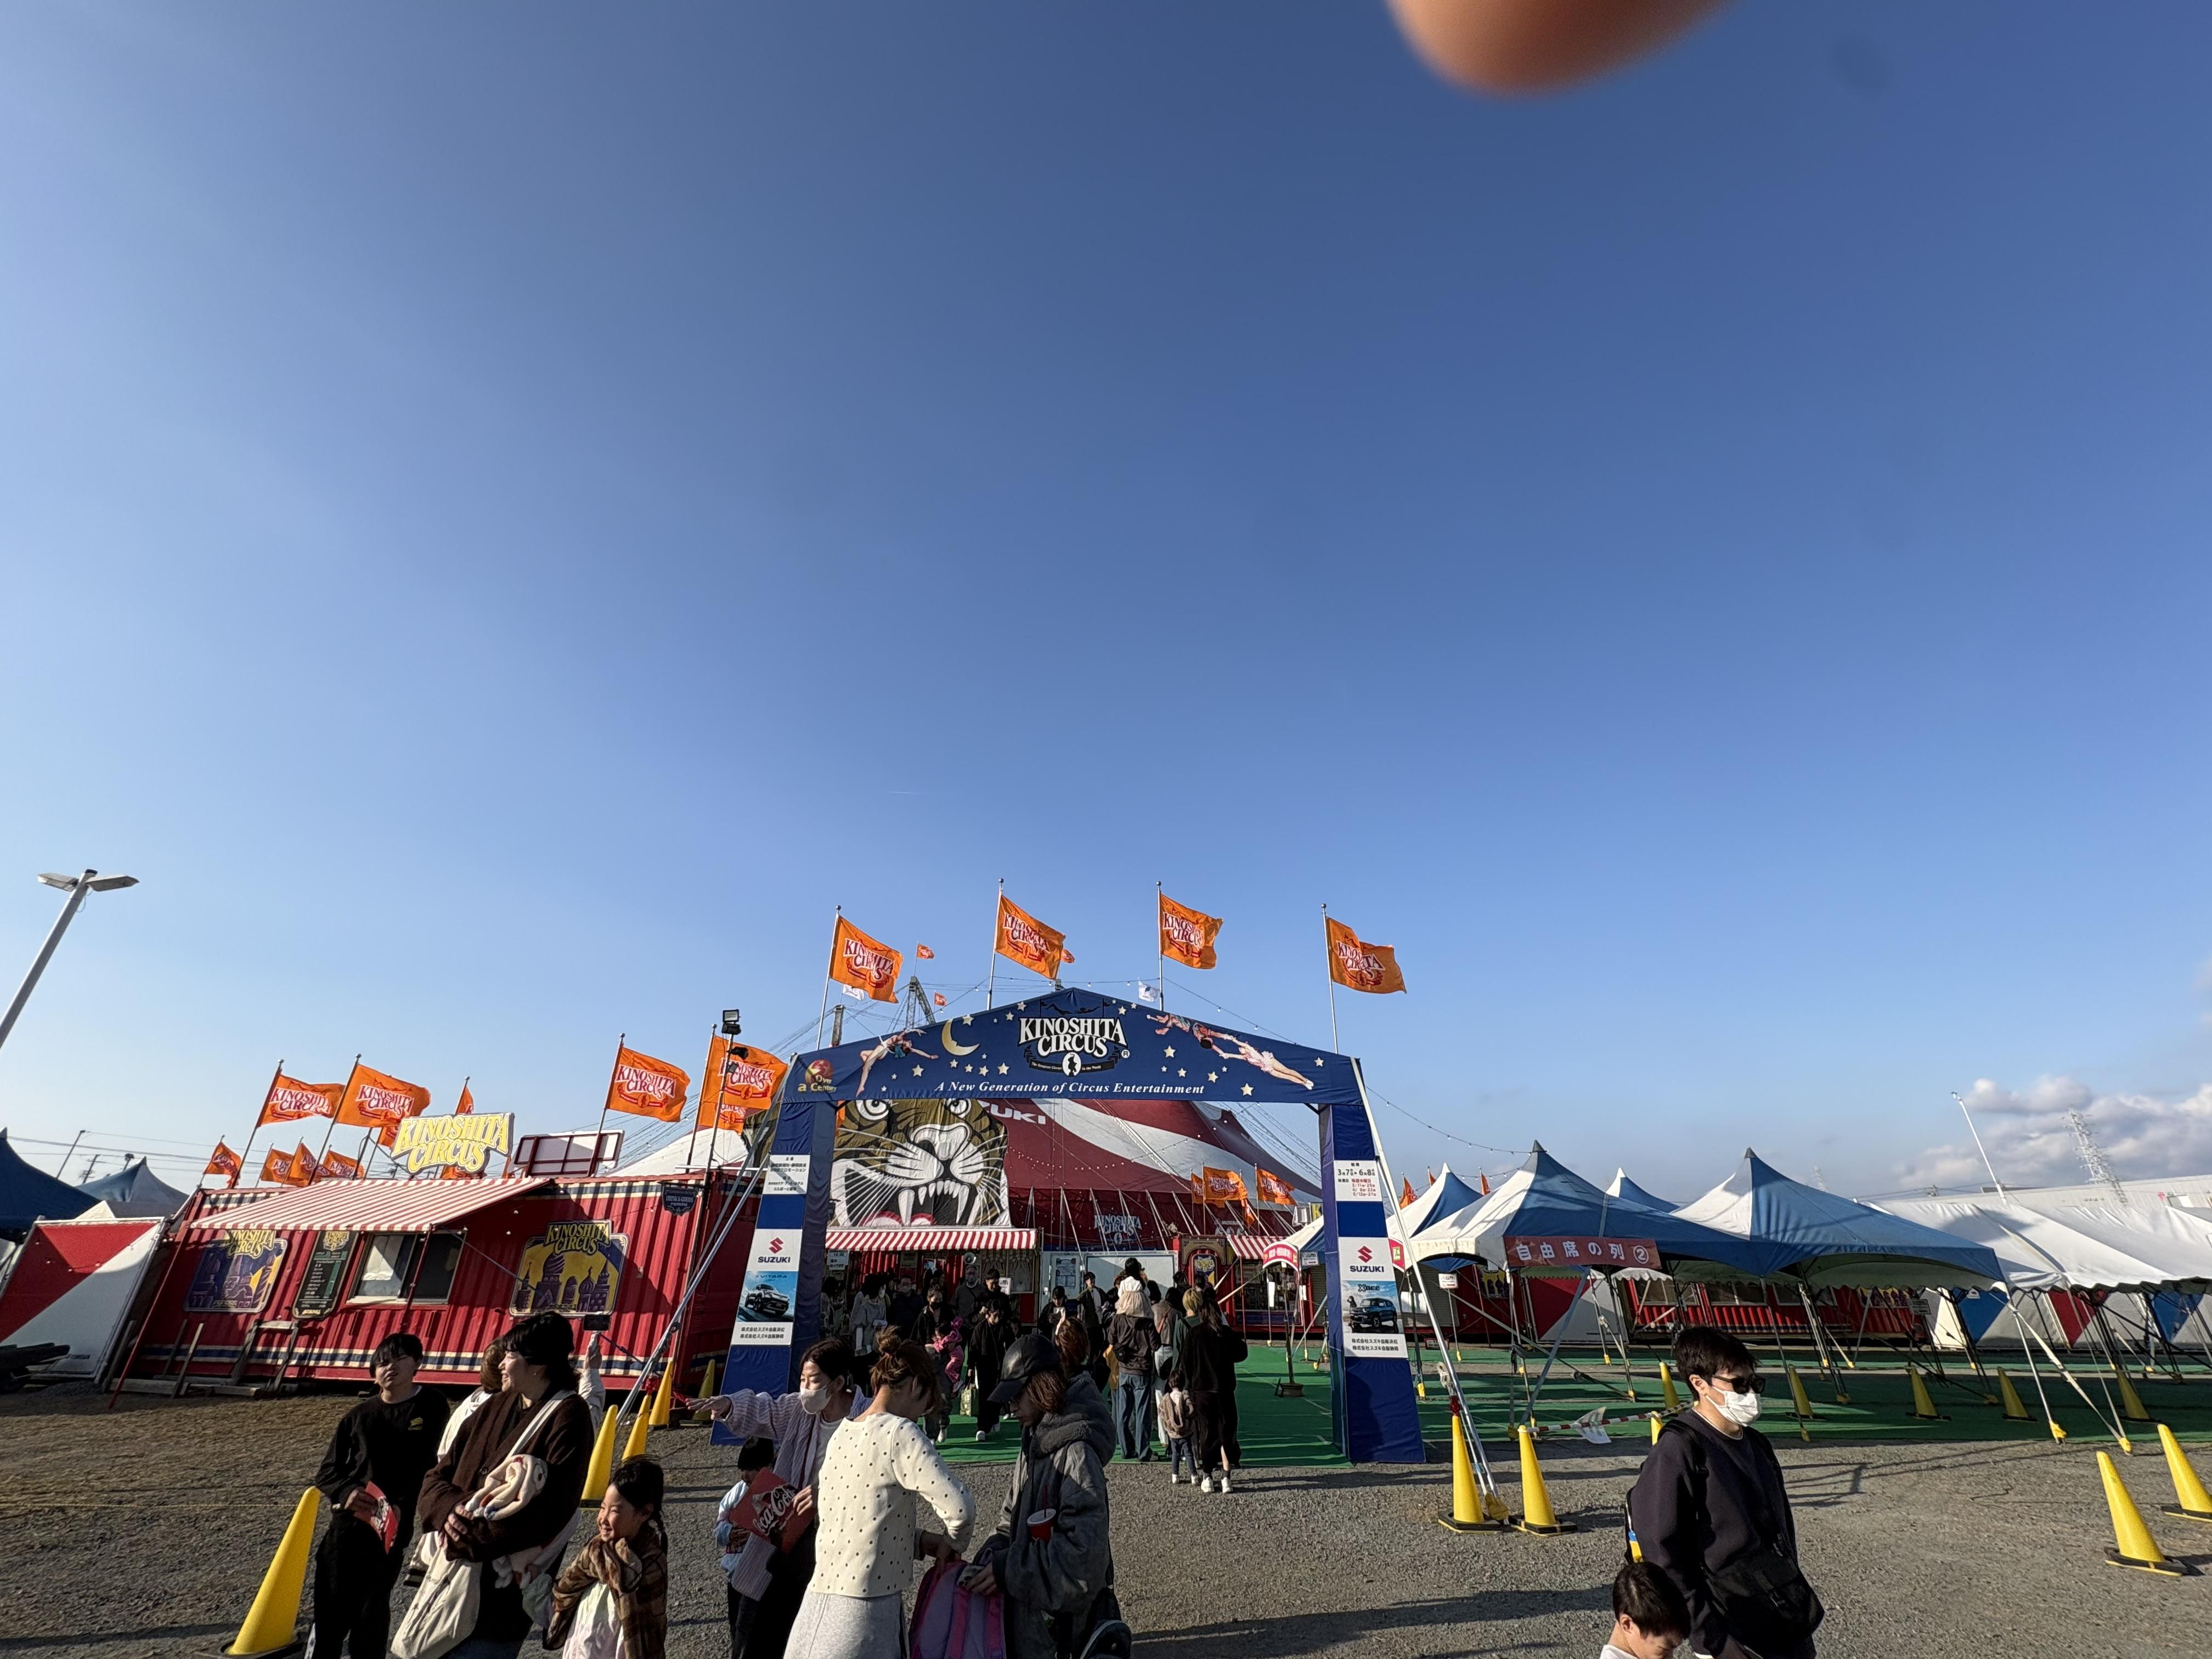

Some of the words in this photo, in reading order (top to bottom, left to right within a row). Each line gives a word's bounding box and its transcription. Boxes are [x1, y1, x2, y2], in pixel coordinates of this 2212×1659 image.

[1019, 1017, 1127, 1046] KINOSHITA
[1038, 1034, 1108, 1057] CIRCUS
[798, 1083, 807, 1092] a
[810, 1082, 837, 1093] Century
[815, 1075, 832, 1084] Over
[934, 1081, 945, 1092] A
[948, 1081, 975, 1092] New
[979, 1081, 1048, 1093] Generation
[1051, 1081, 1064, 1094] of
[1069, 1082, 1109, 1093] Circus
[1113, 1082, 1205, 1094] Entertainment
[391, 1114, 509, 1155] KINOSHITA
[408, 1138, 486, 1173] CIRCUS
[545, 1223, 610, 1244] KINOSHITA
[555, 1237, 597, 1254] CIRCUS
